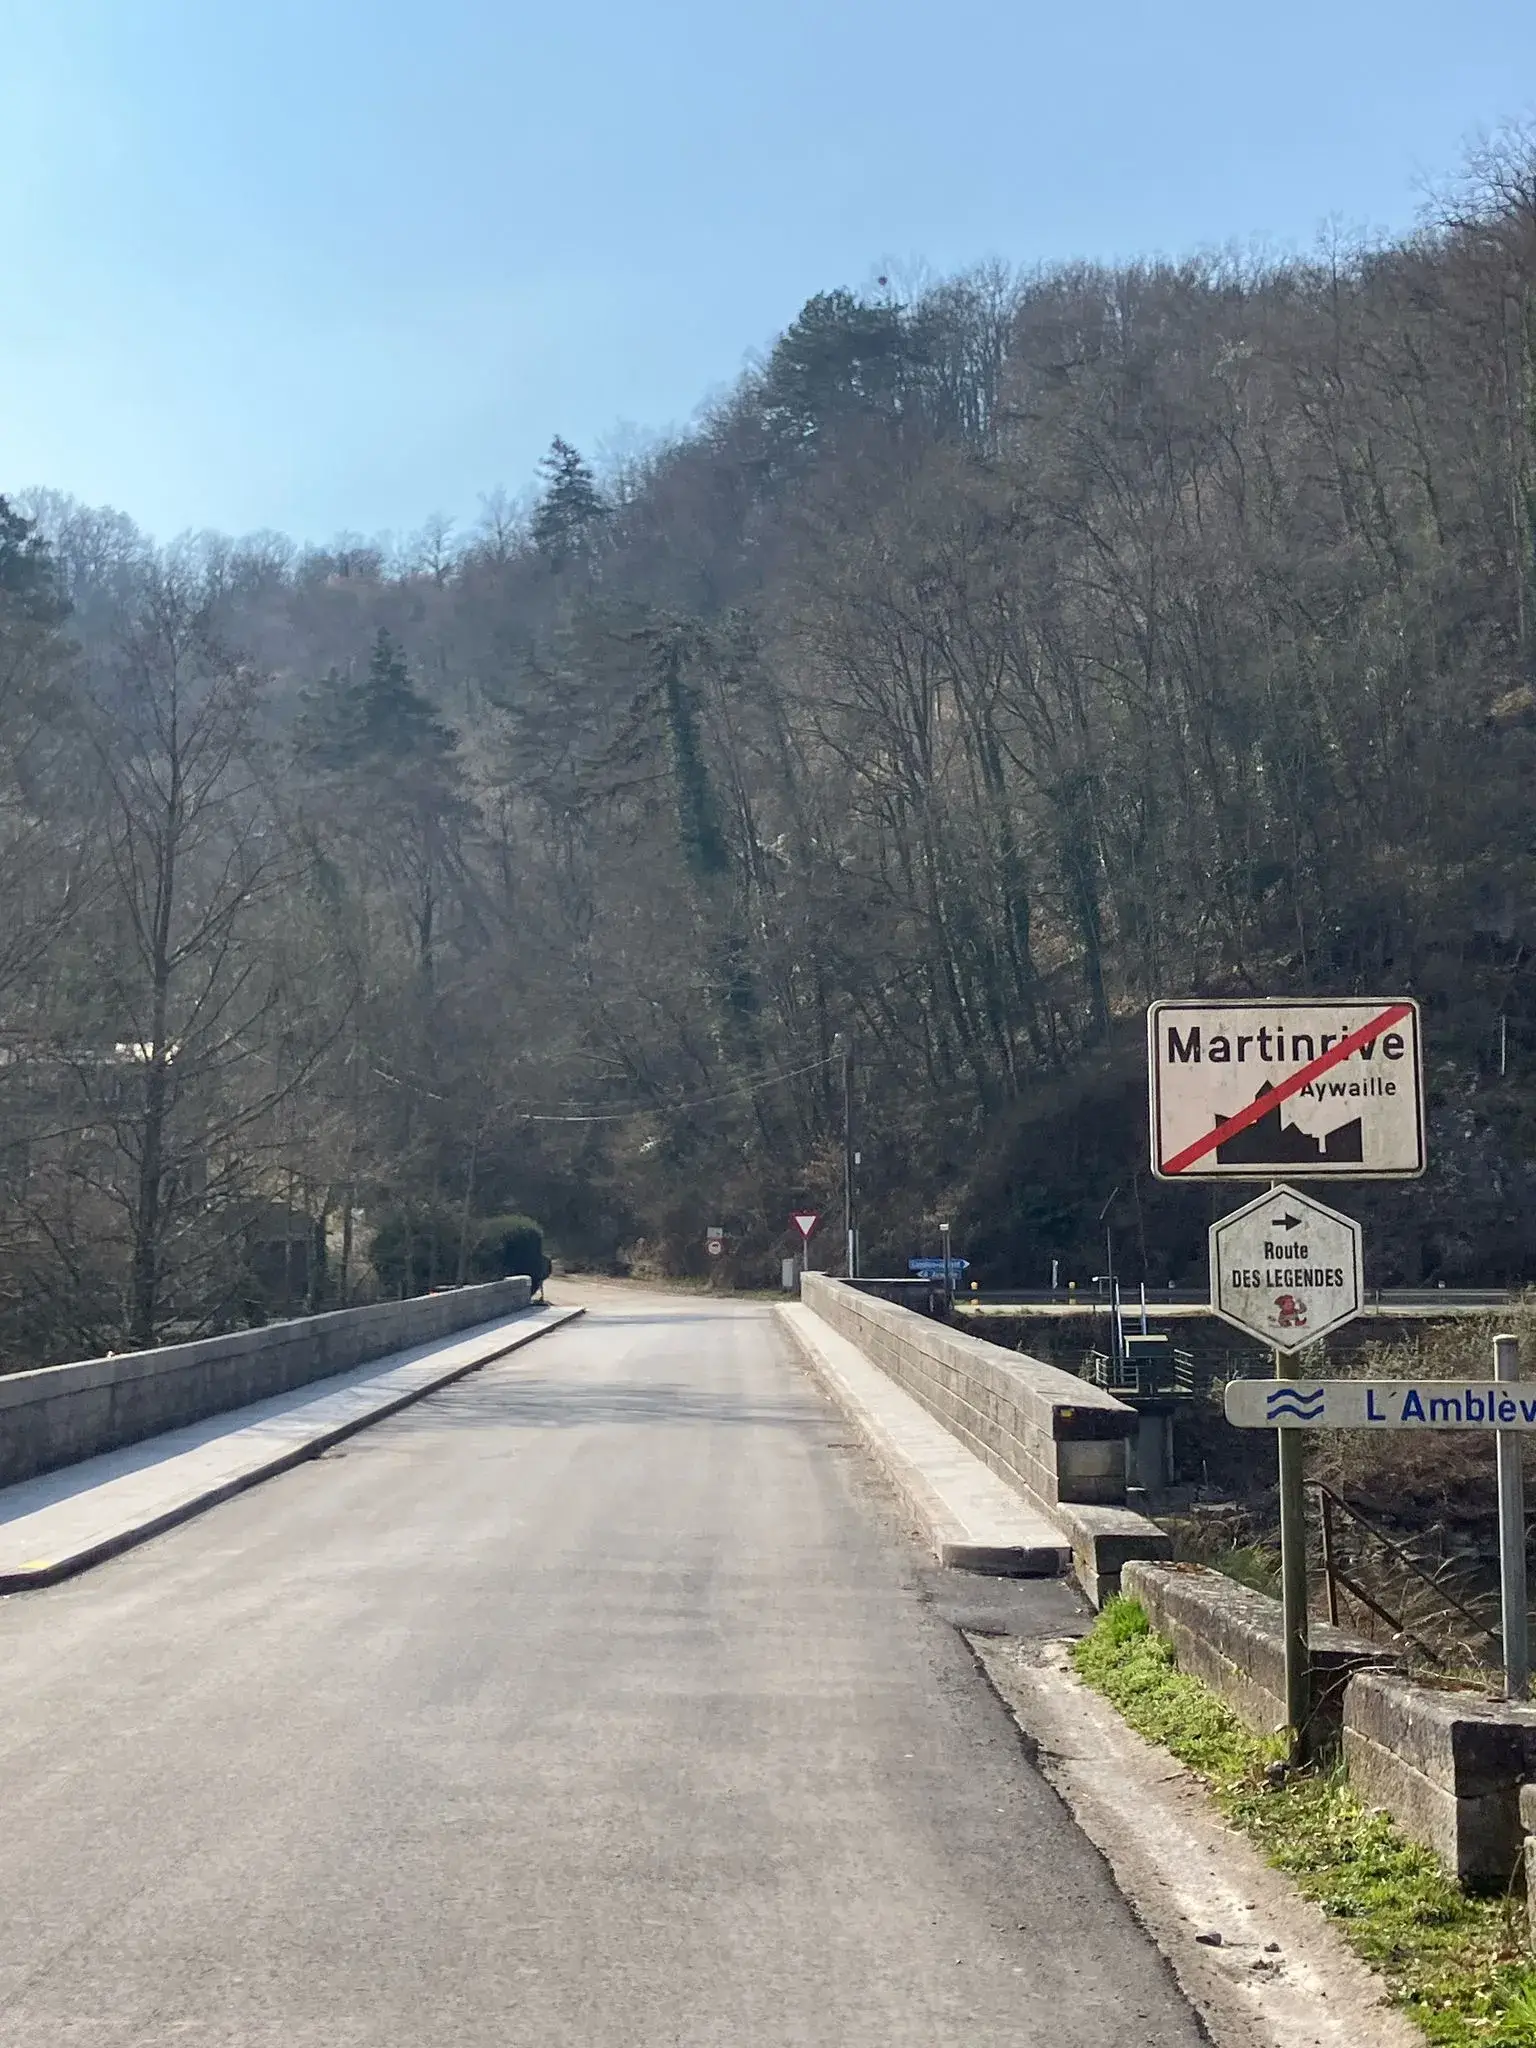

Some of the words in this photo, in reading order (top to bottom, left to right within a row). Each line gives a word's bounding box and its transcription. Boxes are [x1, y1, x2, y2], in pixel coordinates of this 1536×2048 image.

[1301, 1077, 1397, 1102] Aywaille
[1264, 1241, 1309, 1260] Route
[1232, 1269, 1261, 1288] DES
[1266, 1268, 1344, 1288] LEGENDES
